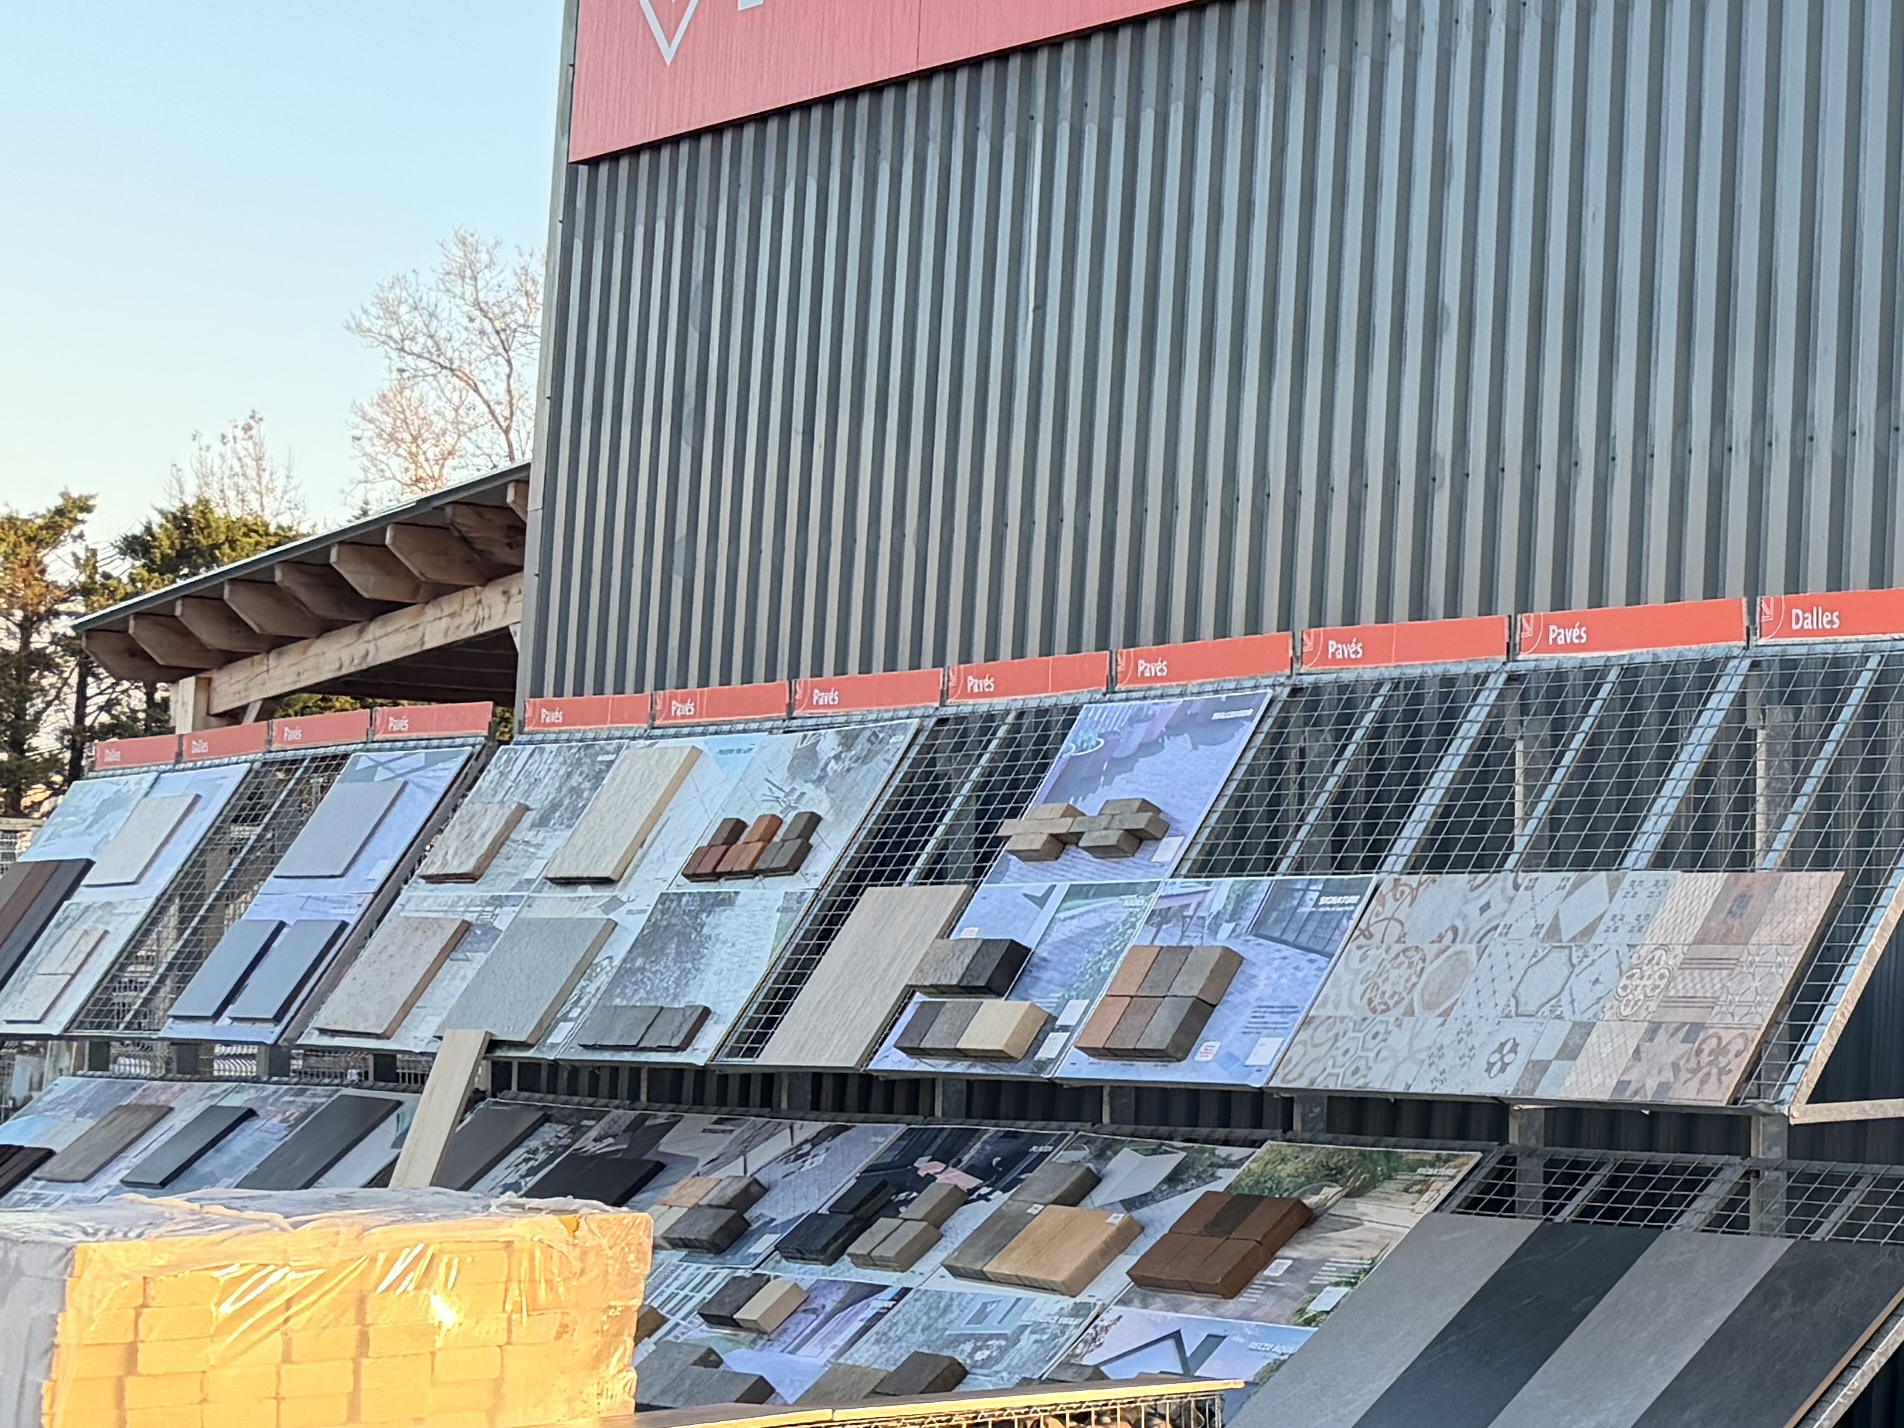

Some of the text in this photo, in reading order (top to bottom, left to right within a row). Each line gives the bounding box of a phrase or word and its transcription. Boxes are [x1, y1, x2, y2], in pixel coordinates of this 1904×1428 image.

[1791, 607, 1841, 631] Dalles
[1548, 621, 1588, 646] Pavés
[1327, 638, 1363, 661] Pavés
[1136, 658, 1169, 678] Pavés
[966, 672, 996, 693] Pavés
[812, 688, 840, 707] Pavés
[540, 706, 564, 724] Pavés
[670, 699, 696, 717] Pavés
